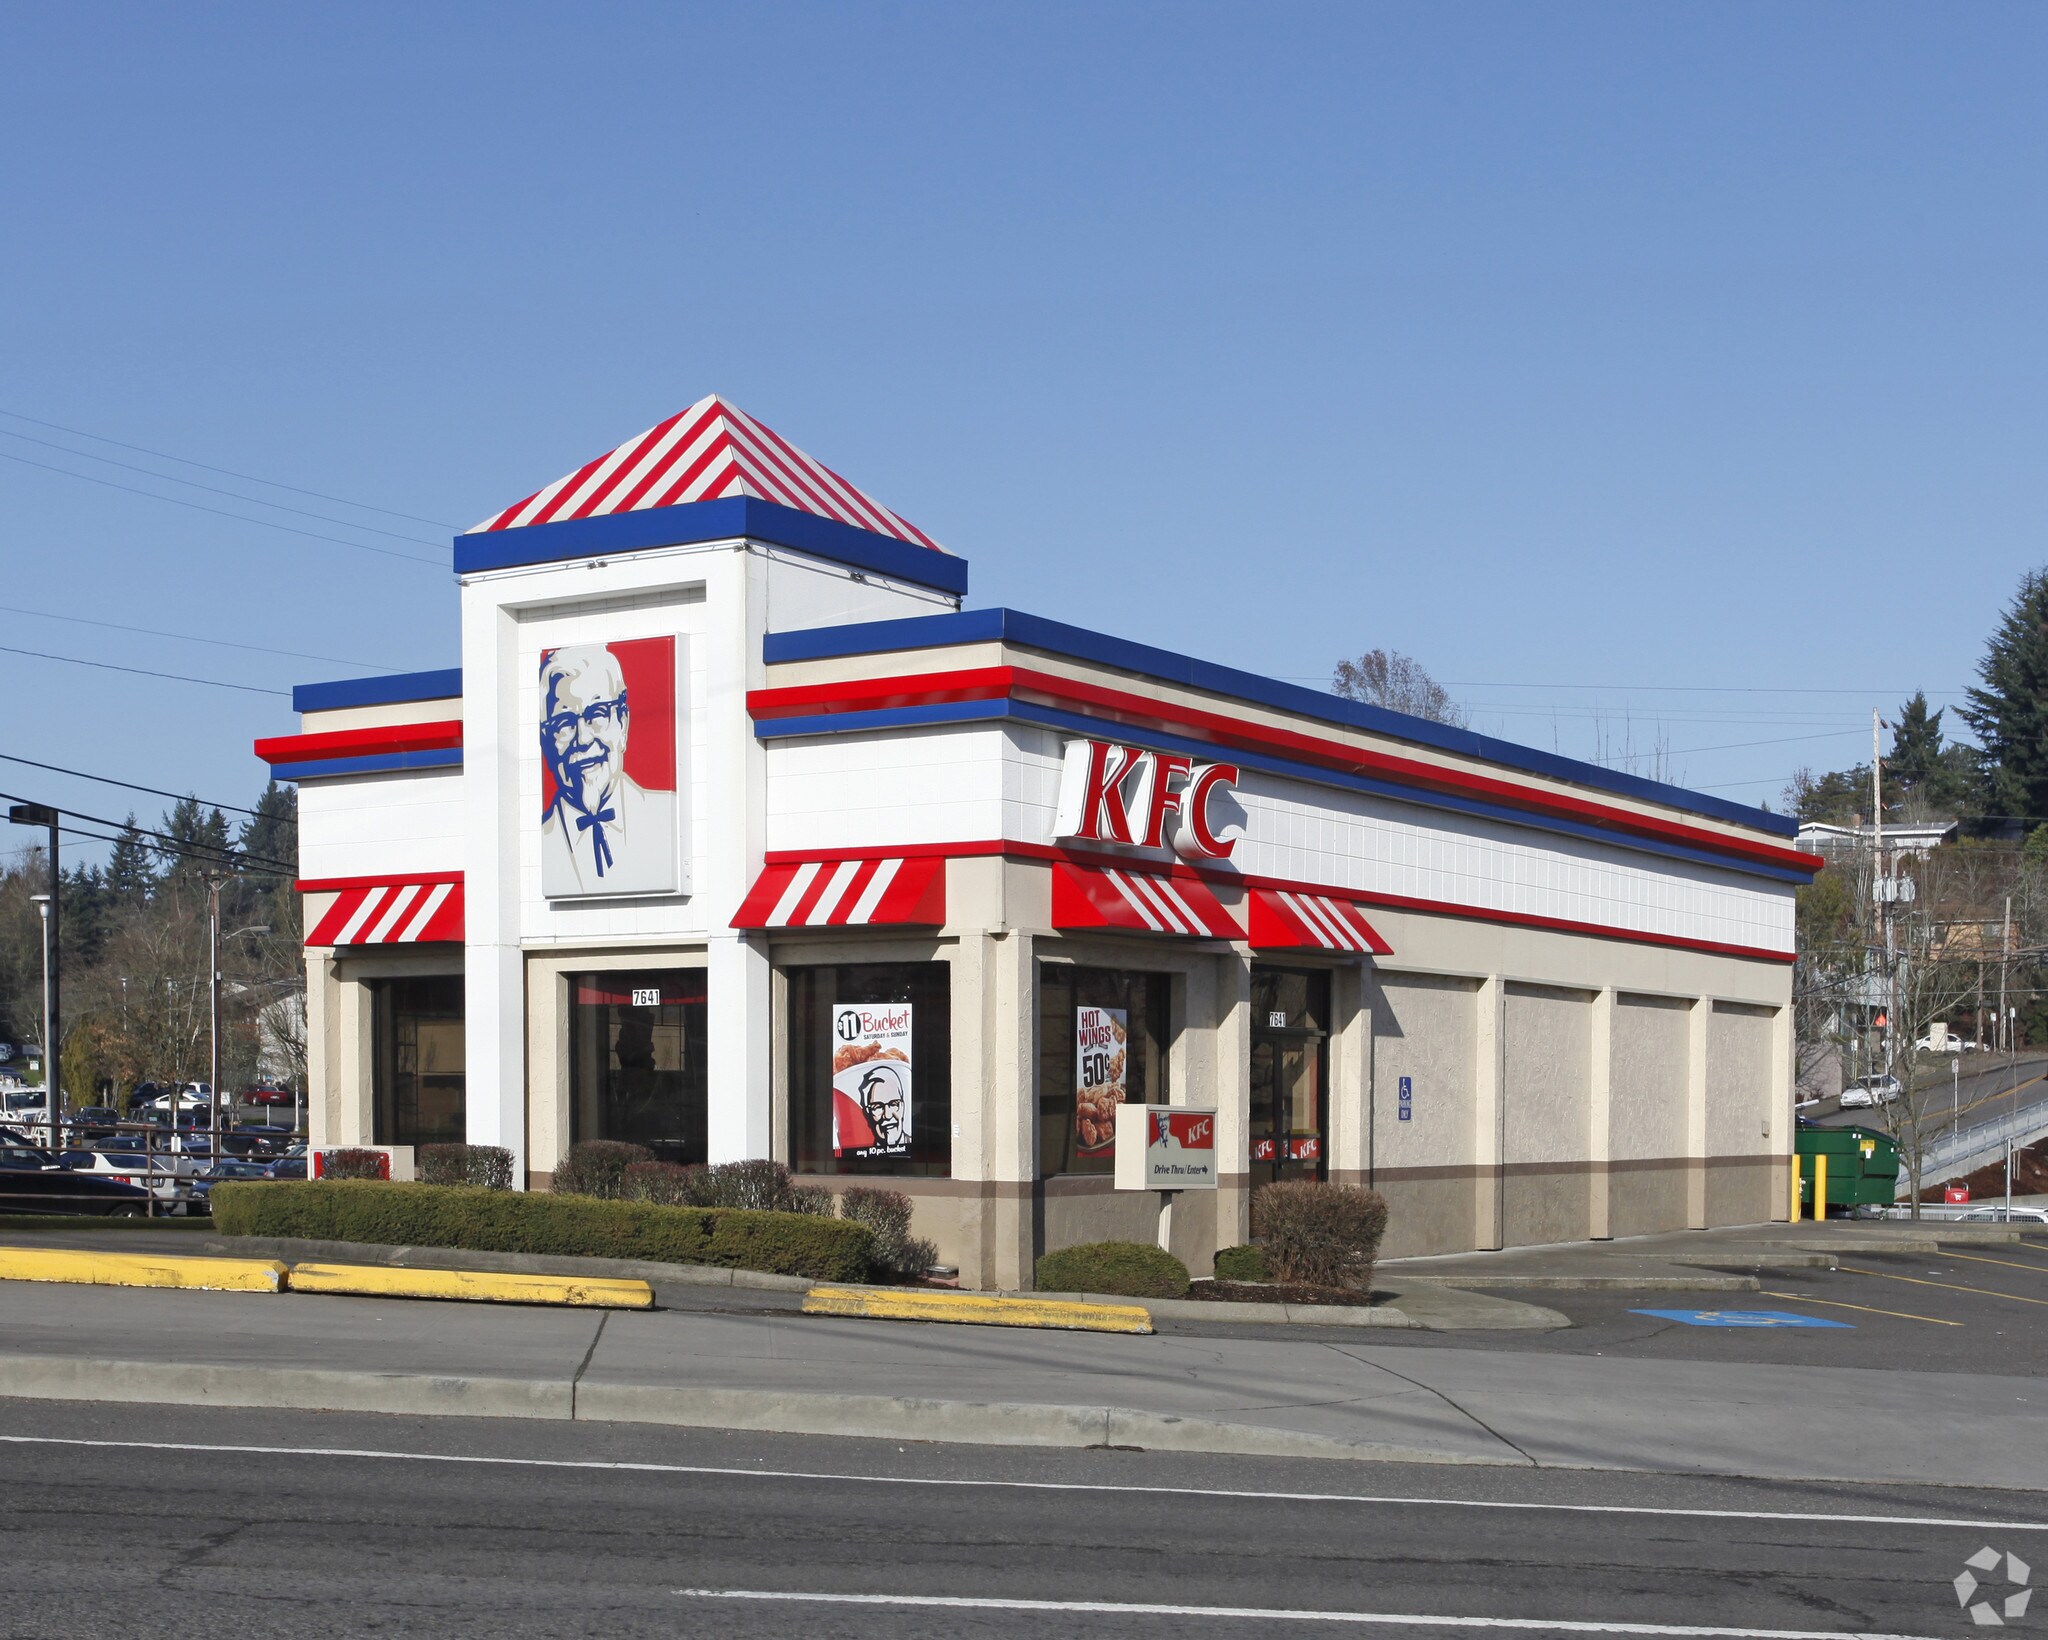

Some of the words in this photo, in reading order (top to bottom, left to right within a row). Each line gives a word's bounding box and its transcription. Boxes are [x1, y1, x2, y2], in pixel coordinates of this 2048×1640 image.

[1072, 739, 1240, 859] KFC
[634, 990, 658, 1005] 7641
[837, 1013, 857, 1039] $11
[859, 1009, 910, 1033] Bucket
[1081, 1010, 1100, 1029] HOT
[1269, 1012, 1286, 1026] 7641
[1079, 1025, 1111, 1046] WINGS
[1187, 1119, 1210, 1144] KFC
[886, 1145, 906, 1154] bucket
[1255, 1139, 1273, 1160] KFC
[1300, 1138, 1317, 1159] KFC
[1154, 1165, 1170, 1175] Drive
